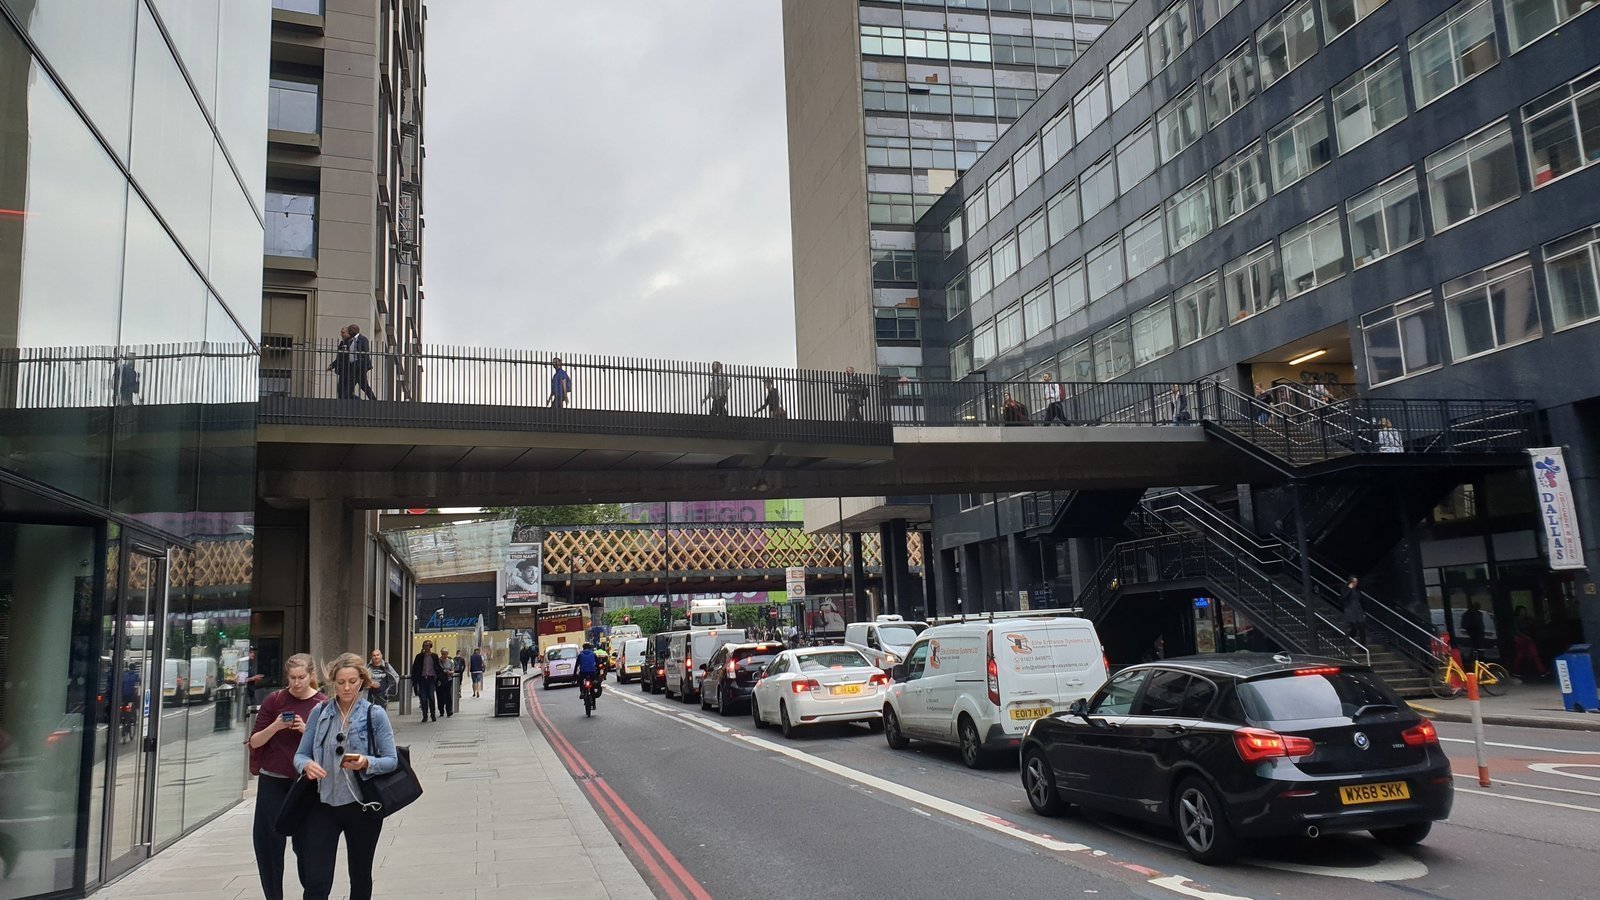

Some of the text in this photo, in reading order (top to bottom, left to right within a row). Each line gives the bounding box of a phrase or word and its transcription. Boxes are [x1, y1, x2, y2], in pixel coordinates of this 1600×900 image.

[1542, 492, 1564, 560] DALLAS
[1015, 709, 1031, 718] EO17
[1344, 783, 1405, 801] WX68 SKK
